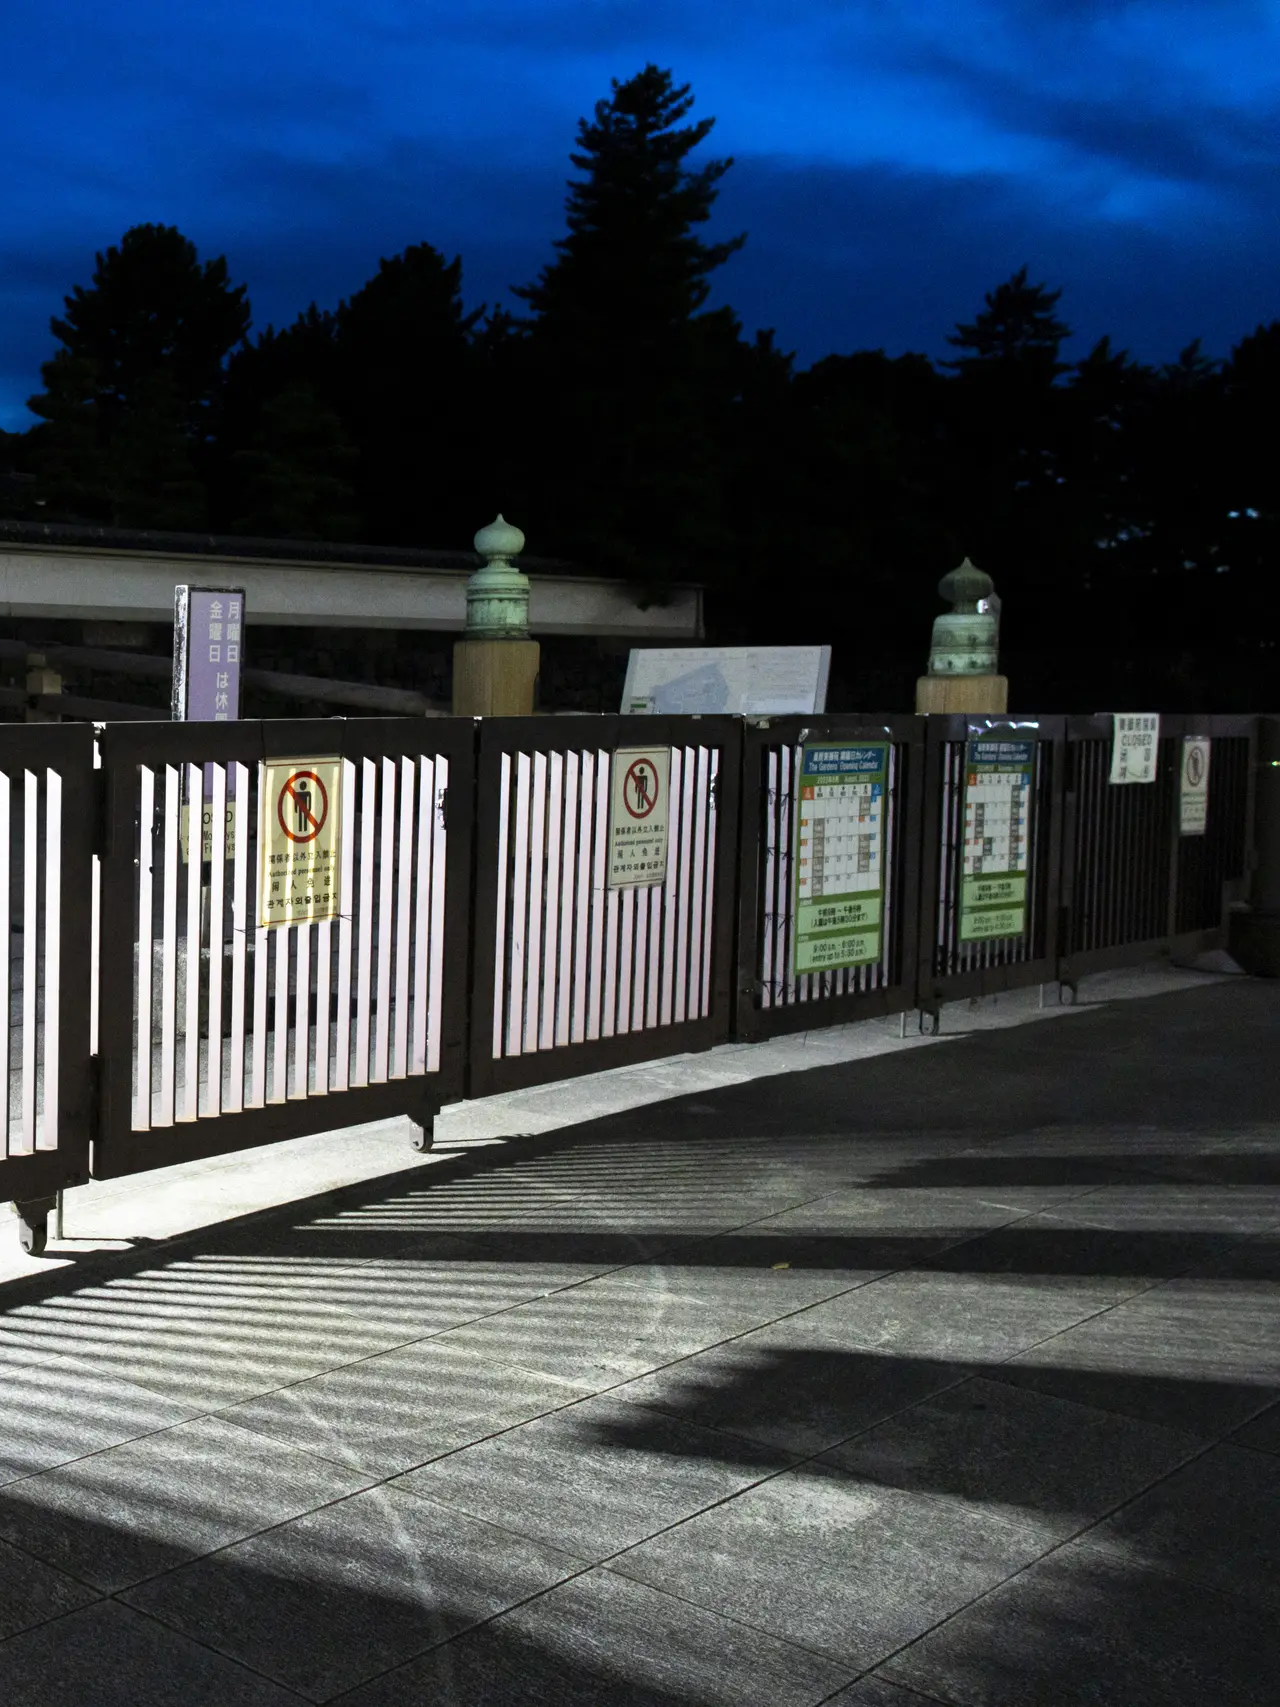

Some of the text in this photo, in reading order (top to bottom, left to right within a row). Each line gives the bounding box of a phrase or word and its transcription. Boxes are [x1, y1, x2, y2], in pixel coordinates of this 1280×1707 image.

[209, 600, 223, 662] 金曜日
[226, 601, 240, 662] 月曜日
